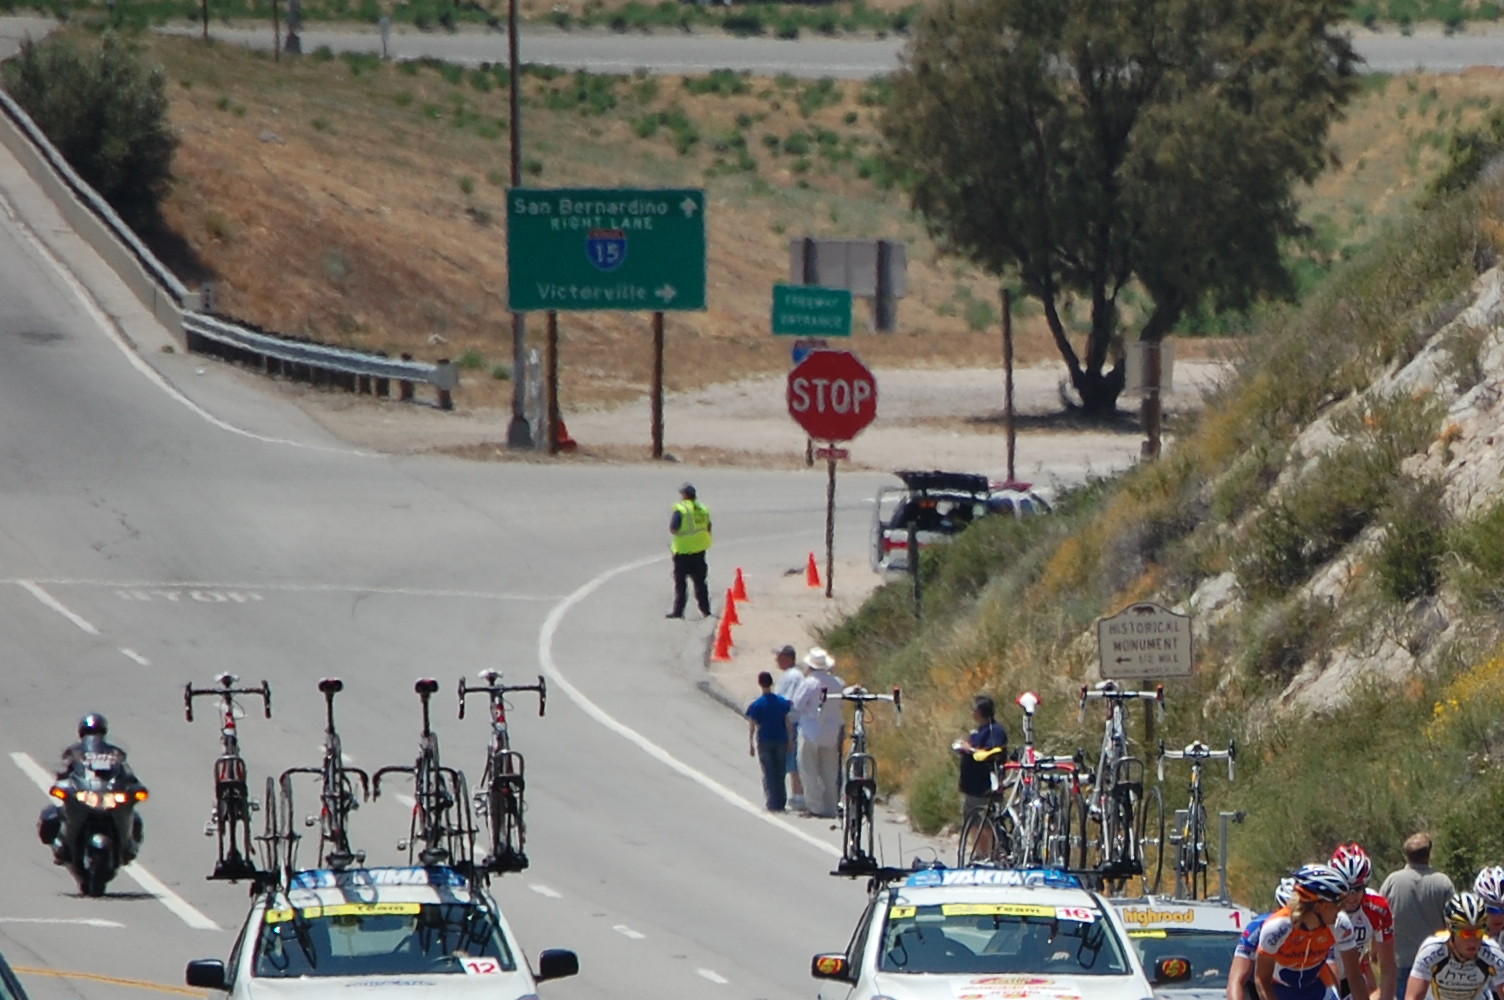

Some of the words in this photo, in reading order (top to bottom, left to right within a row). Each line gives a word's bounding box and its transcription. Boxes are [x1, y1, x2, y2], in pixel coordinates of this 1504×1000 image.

[514, 198, 551, 216] San
[559, 198, 669, 216] Bernardino
[551, 216, 604, 231] RIGHT
[610, 216, 654, 230] LANE
[595, 242, 620, 263] 15
[536, 282, 647, 301] Victorville
[791, 377, 872, 414] STOP
[1108, 621, 1181, 635] HISTORICAL
[1113, 638, 1178, 652] MONUMENT
[995, 905, 1041, 914] Team
[1062, 906, 1091, 920] 16
[1123, 907, 1195, 927] highroad
[1229, 911, 1241, 929] 1
[466, 961, 497, 973] 12
